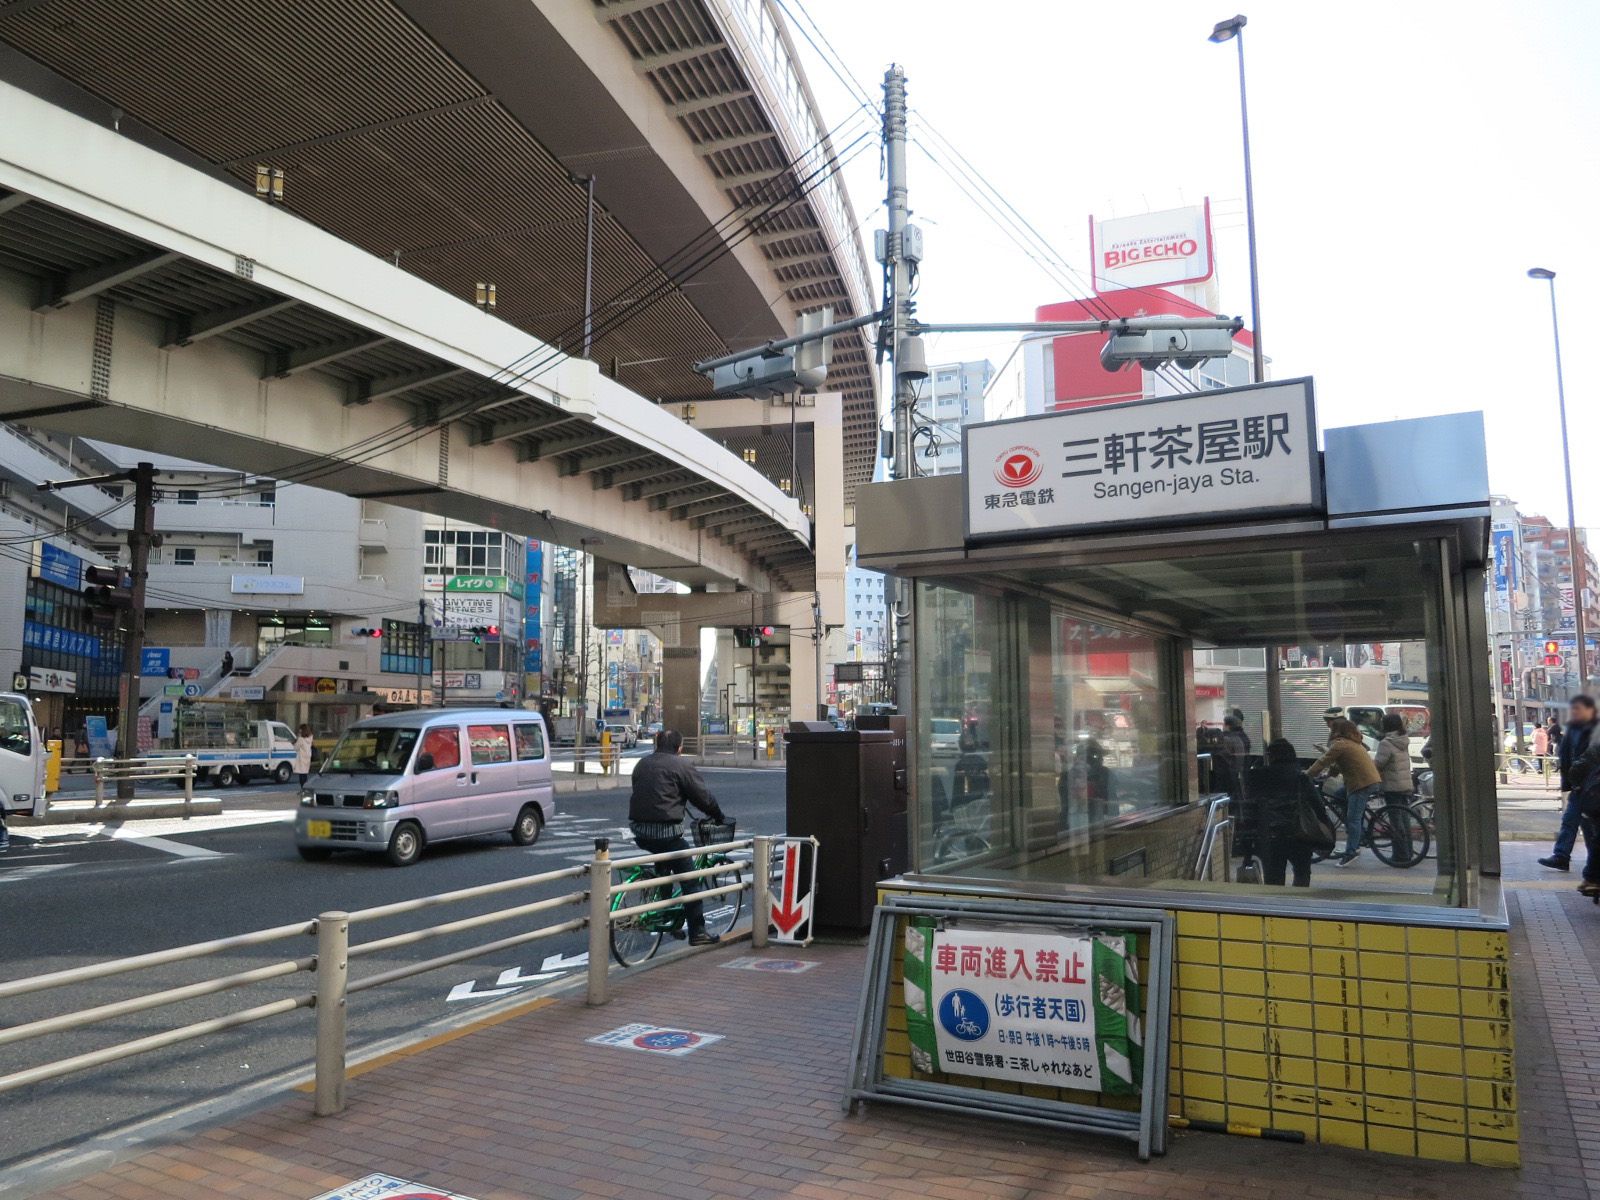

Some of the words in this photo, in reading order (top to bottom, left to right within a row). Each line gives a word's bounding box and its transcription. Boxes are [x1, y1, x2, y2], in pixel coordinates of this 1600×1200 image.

[1104, 248, 1140, 269] BIG
[1143, 239, 1198, 258] ECHO
[1061, 412, 1292, 478] 三軒茶屋駅
[1093, 472, 1214, 500] Sangen-jaya
[1219, 467, 1260, 485] Sta.
[984, 488, 1055, 510] 東急電鉄
[456, 578, 483, 588] レイク
[188, 686, 196, 696] 3
[935, 943, 1087, 985] 車両進入禁止
[994, 992, 1087, 1023] (歩行者天国)
